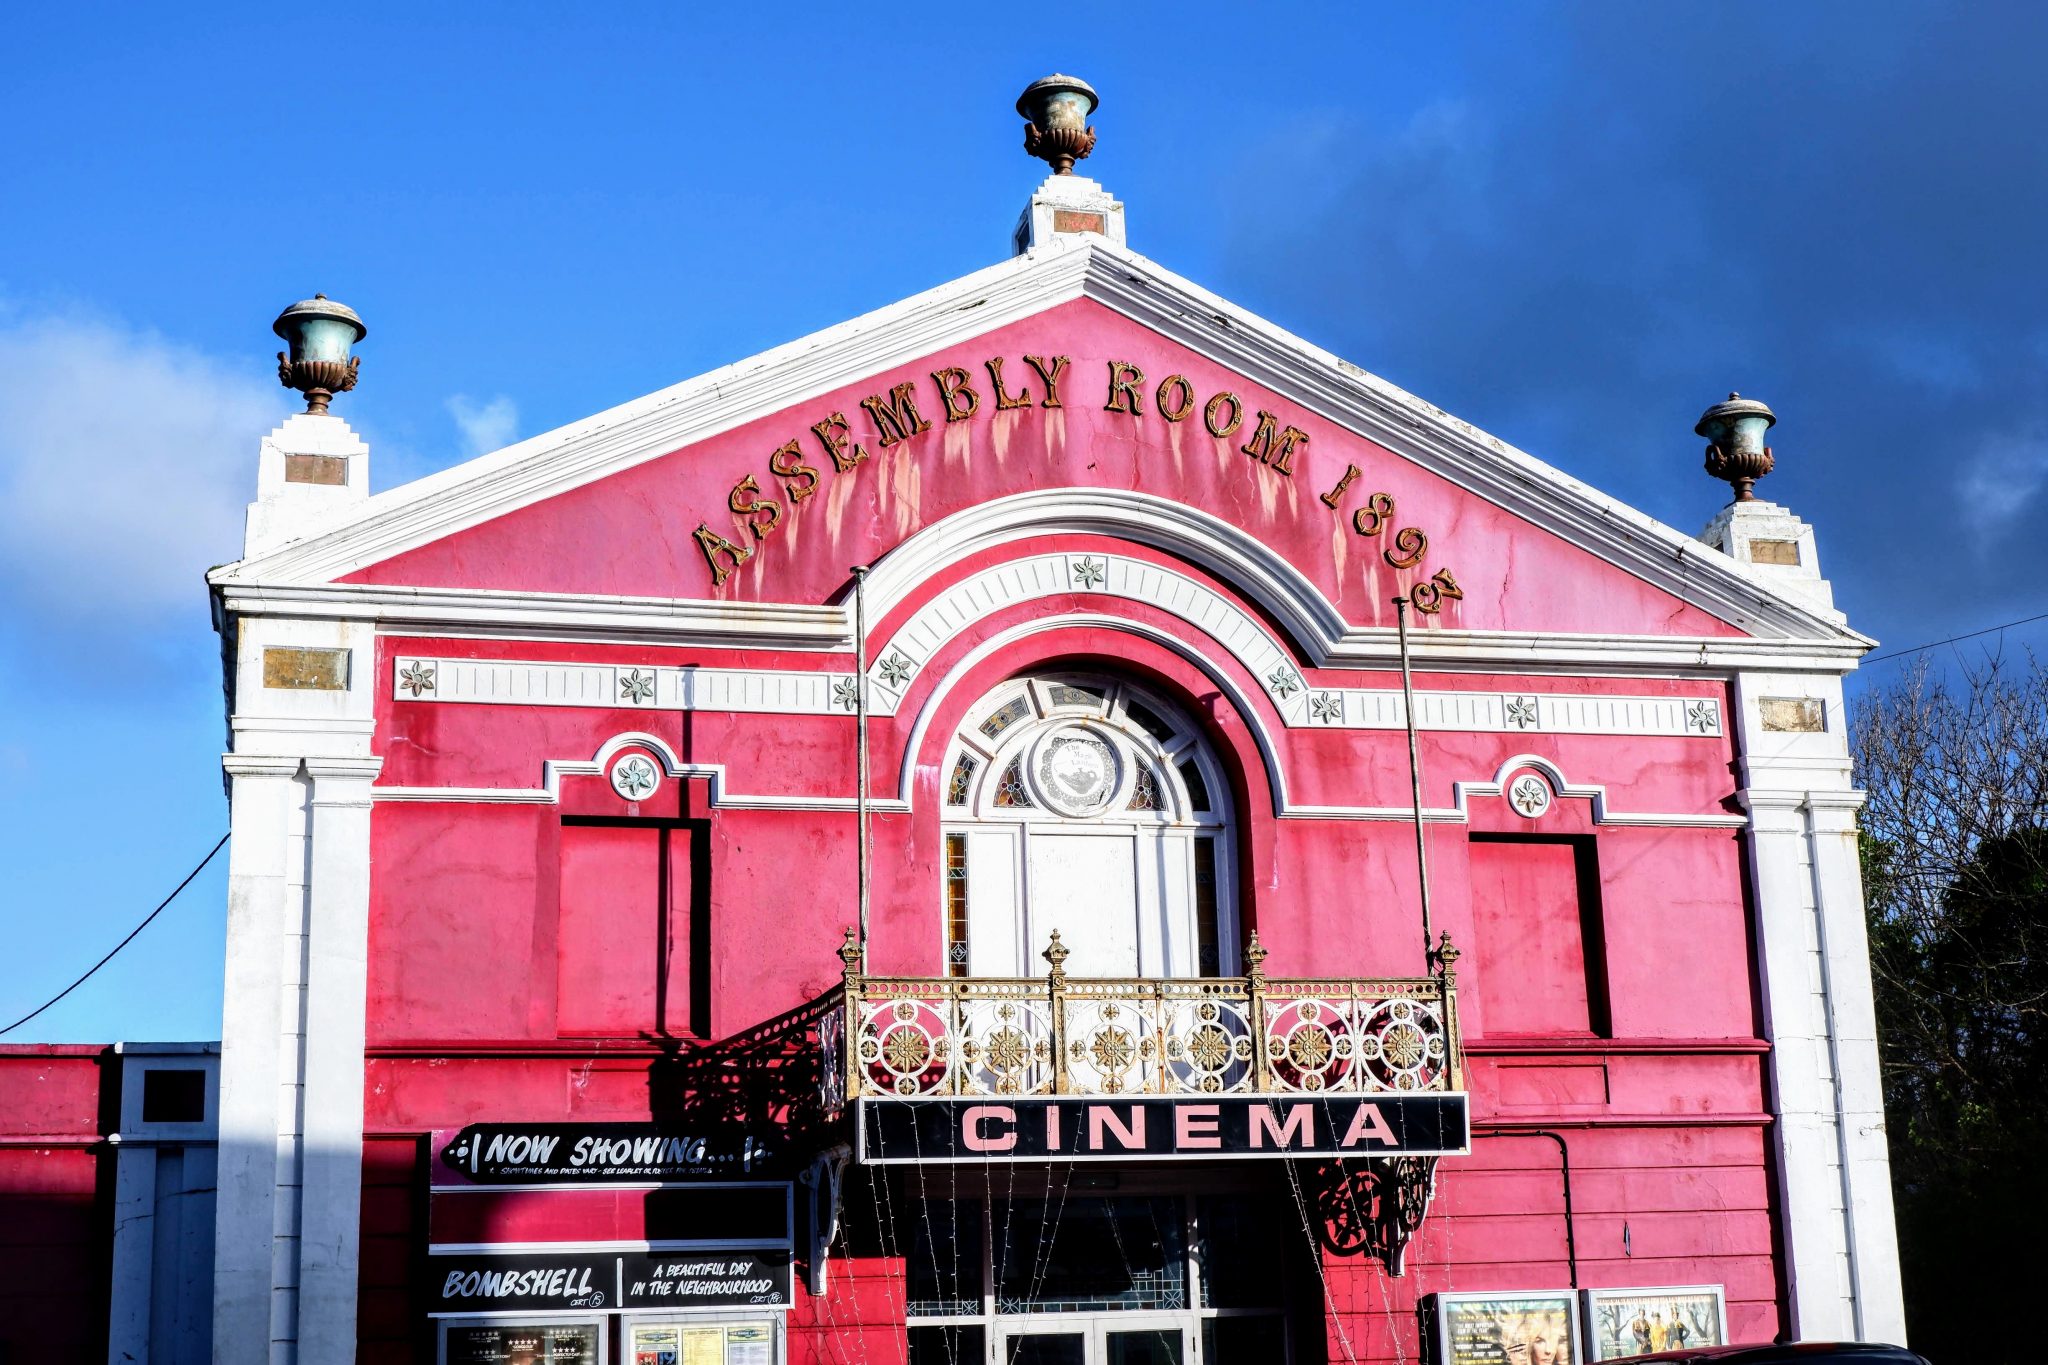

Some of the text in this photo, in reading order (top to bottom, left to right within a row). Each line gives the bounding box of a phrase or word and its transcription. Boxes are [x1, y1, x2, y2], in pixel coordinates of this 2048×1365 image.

[692, 354, 1464, 613] ASSEMBLY ROOM 1893
[962, 1103, 1399, 1152] CINEMA
[484, 1133, 560, 1164] NOW
[602, 1167, 616, 1175] SEE
[653, 1262, 752, 1278] A BEAUTIFUL DAY
[442, 1267, 593, 1299] BOMBSHELL
[630, 1279, 772, 1296] IN THE NEIGHBOURHOOD
[570, 1297, 588, 1307] CERT
[750, 1295, 768, 1303] CERT
